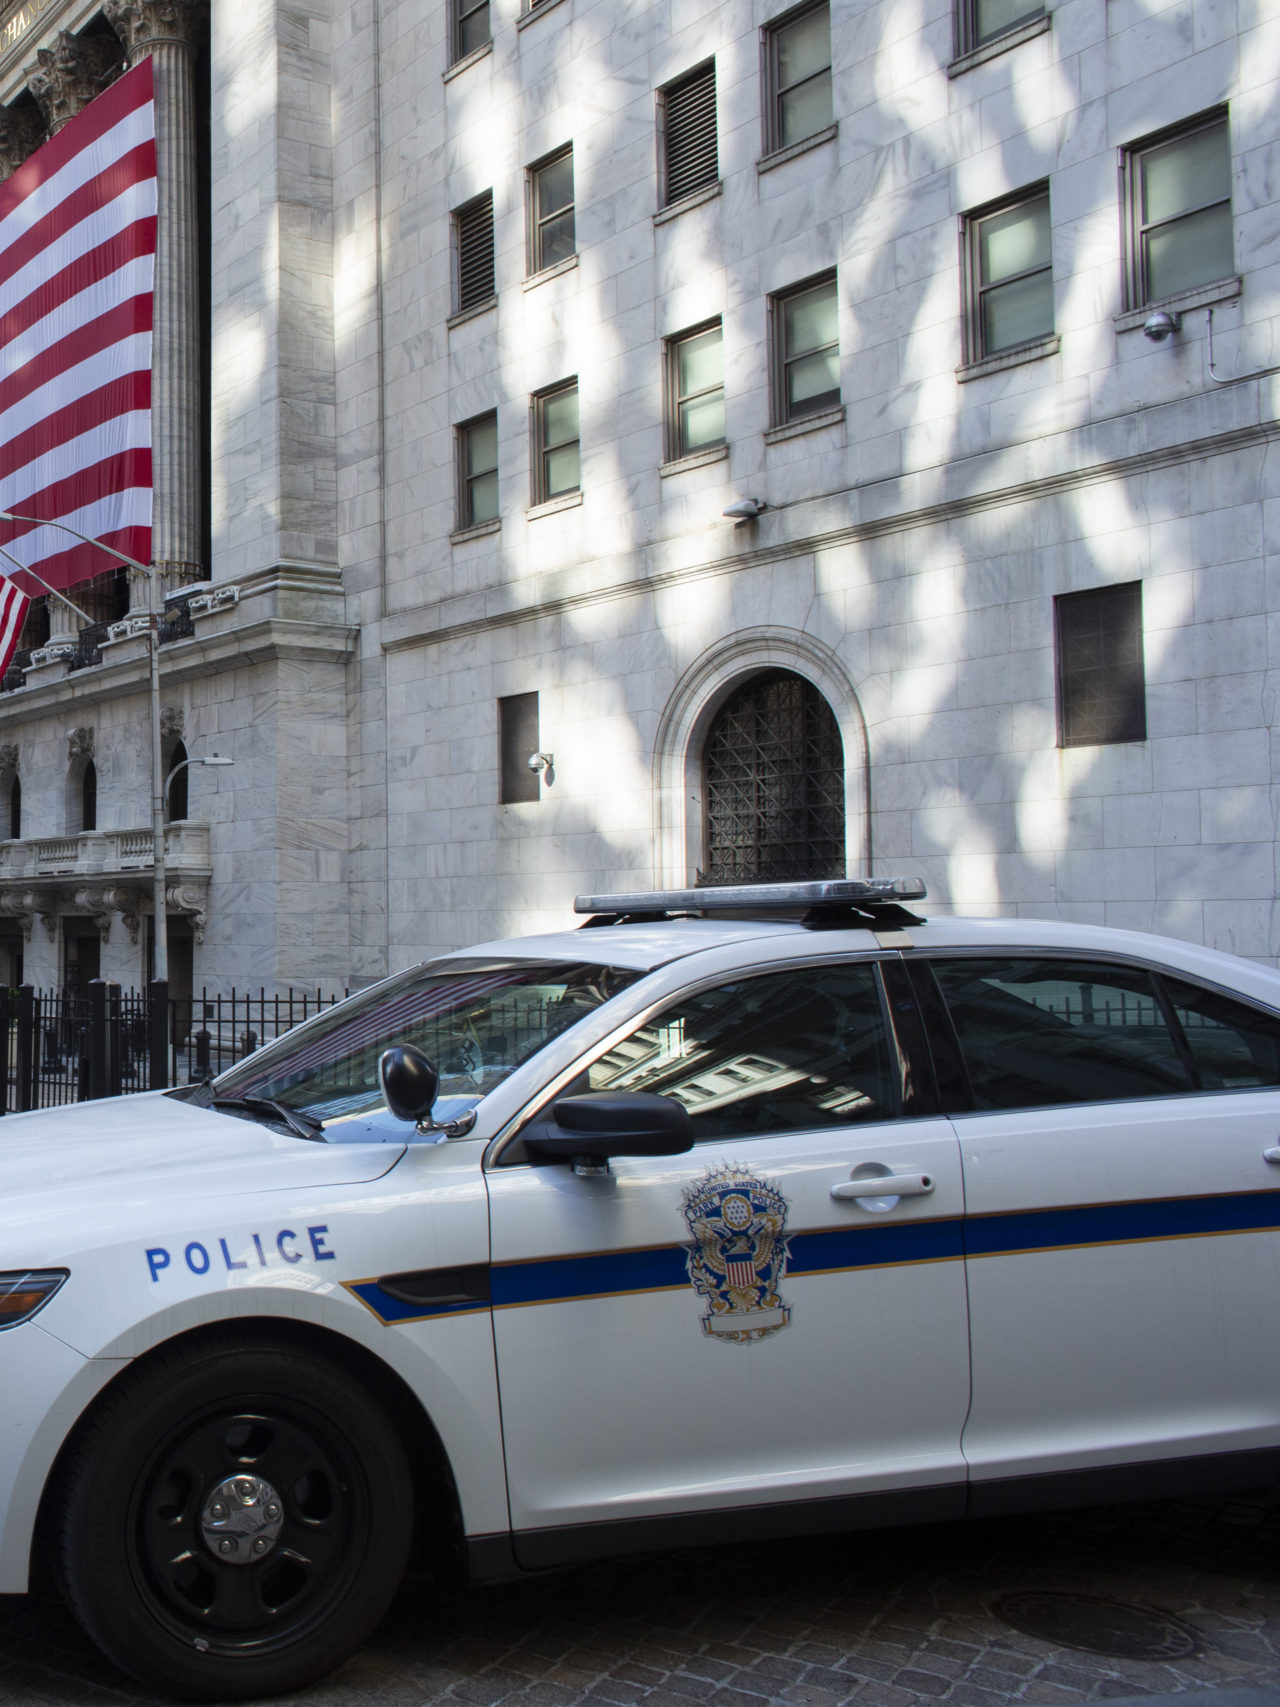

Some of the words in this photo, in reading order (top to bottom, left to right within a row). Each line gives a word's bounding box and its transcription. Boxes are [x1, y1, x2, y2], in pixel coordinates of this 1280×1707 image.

[704, 1182, 730, 1194] UNITED
[734, 1181, 758, 1190] STATES
[692, 1200, 716, 1218] PARK
[752, 1194, 785, 1216] POLICE
[145, 1225, 336, 1283] POLICE
